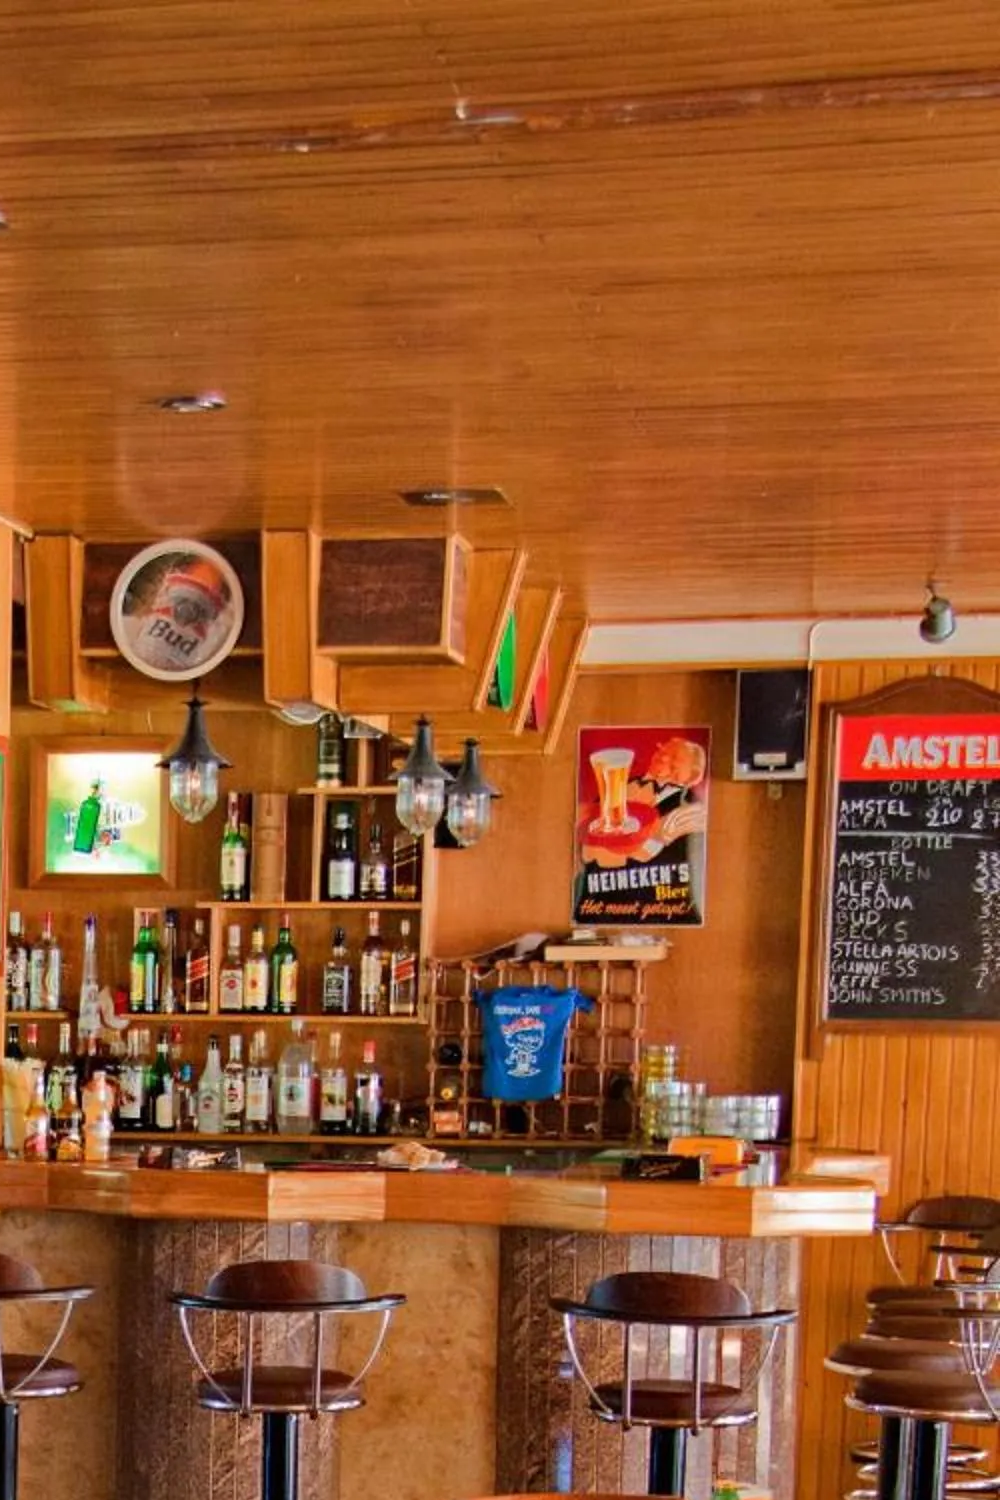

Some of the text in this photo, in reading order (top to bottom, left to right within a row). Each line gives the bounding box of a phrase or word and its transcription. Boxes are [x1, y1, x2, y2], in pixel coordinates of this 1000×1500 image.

[148, 619, 199, 657] Bud
[861, 732, 1000, 770] AMSTEL
[889, 780, 992, 797] ON DRAFT
[840, 799, 911, 816] AMSTEL
[838, 813, 887, 829] ALFA
[891, 834, 952, 850] BOTTLE
[838, 851, 916, 868] AMSTEL
[587, 863, 689, 893] HEINEKEN'S
[655, 884, 689, 900] Bier
[836, 881, 889, 899] ALFA
[836, 896, 914, 911] CORONA
[836, 910, 880, 925] BUD
[832, 942, 960, 961] STELLA ARTOIS
[830, 975, 881, 989] LEFFE
[829, 988, 873, 1003] JOHN
